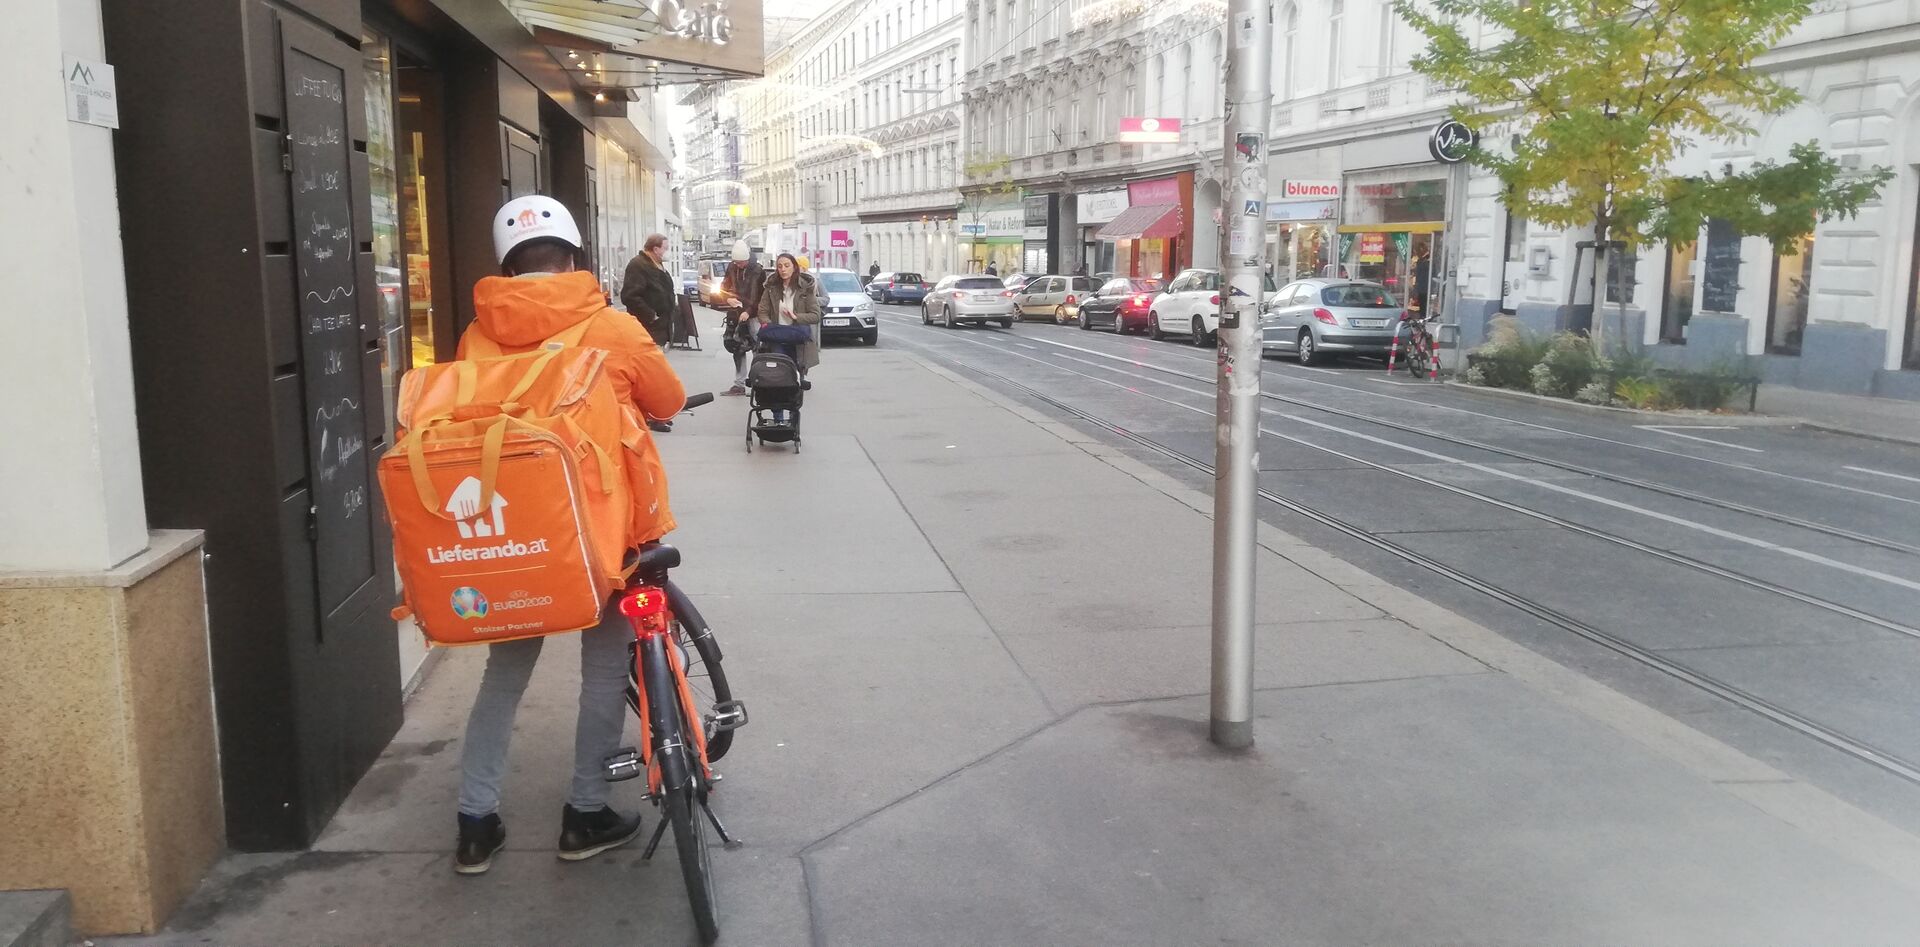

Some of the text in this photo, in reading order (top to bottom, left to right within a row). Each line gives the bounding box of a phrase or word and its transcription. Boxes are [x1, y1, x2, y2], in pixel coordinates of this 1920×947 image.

[652, 0, 734, 45] Café
[1287, 182, 1338, 196] blumen
[426, 537, 550, 564] Lieferando.at
[472, 620, 544, 634] Stolzer Partner
